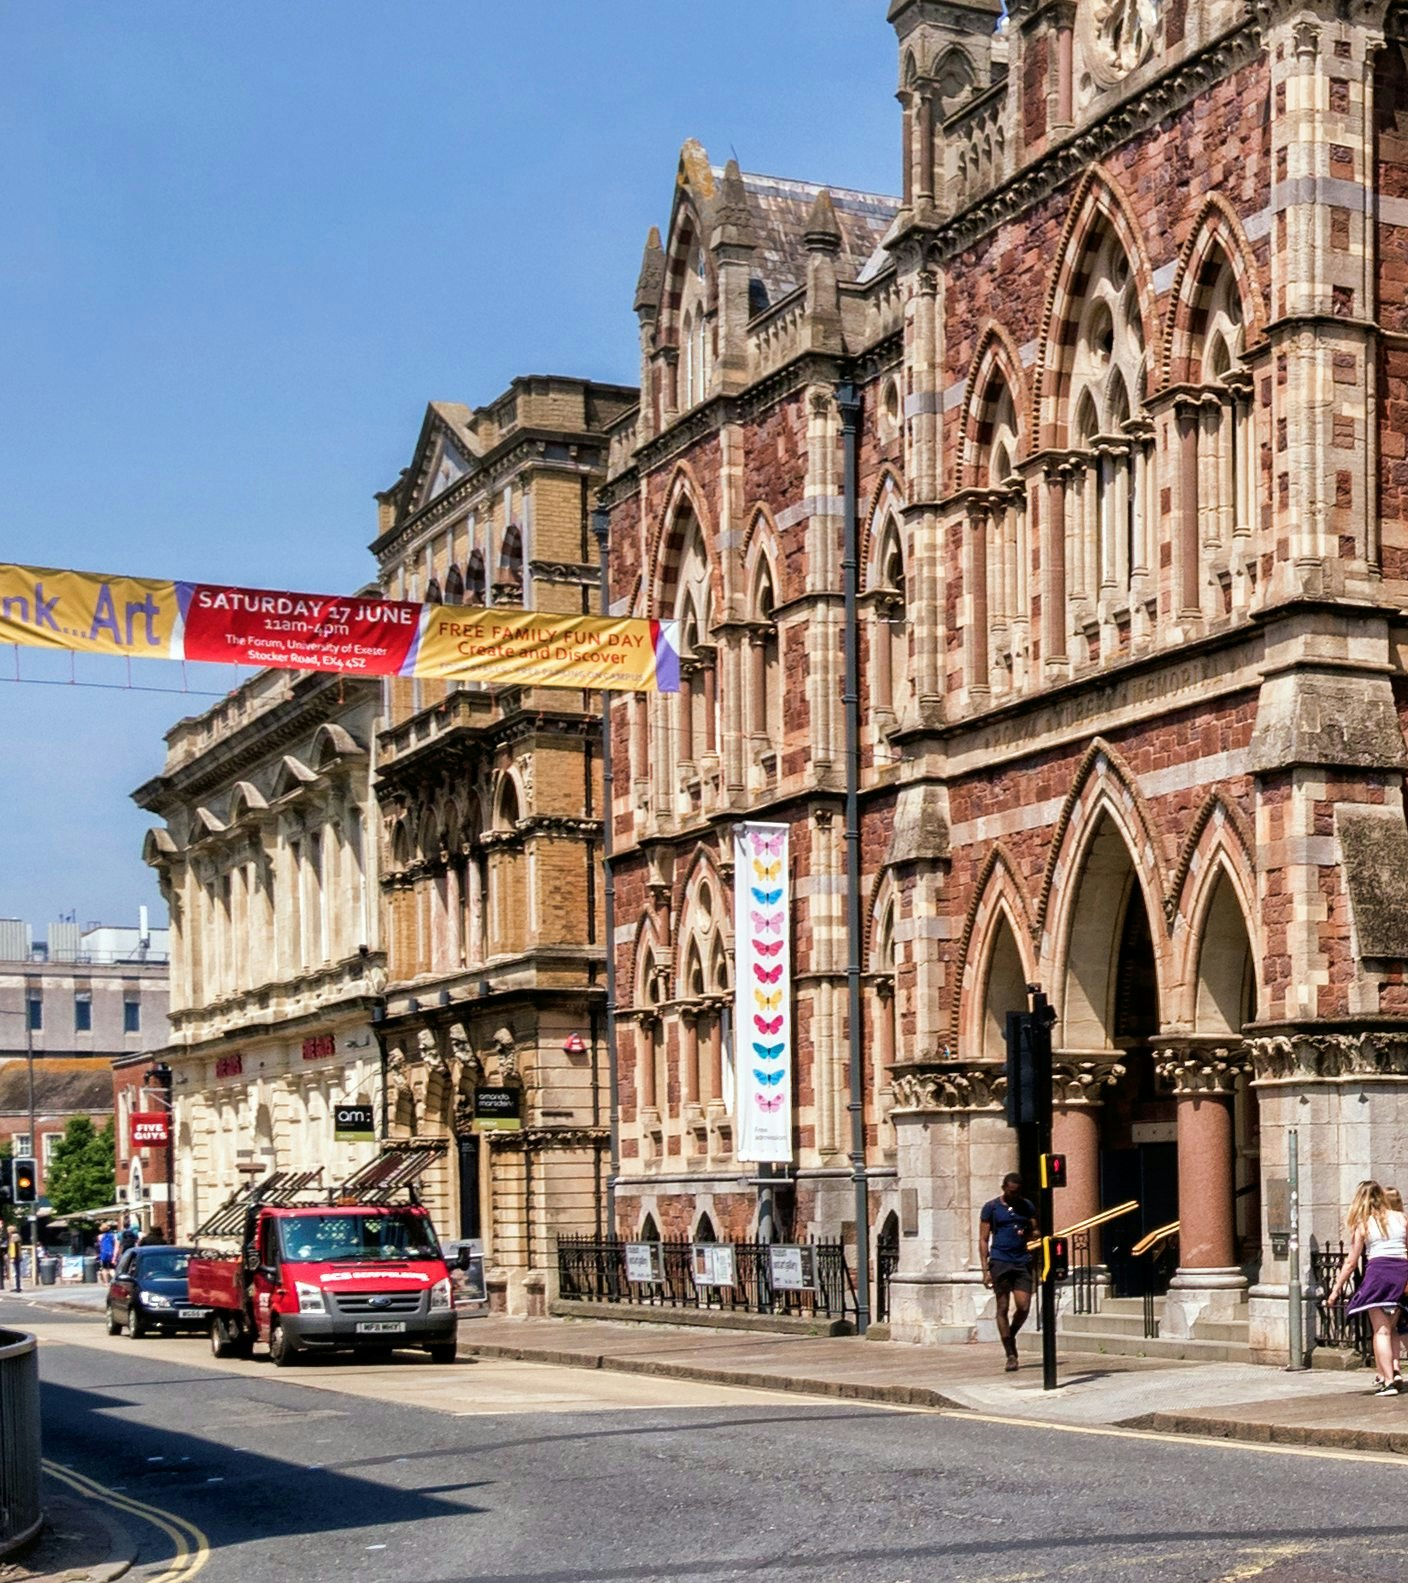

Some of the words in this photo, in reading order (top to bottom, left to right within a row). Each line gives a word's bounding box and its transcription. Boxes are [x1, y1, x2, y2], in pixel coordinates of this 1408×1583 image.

[198, 590, 324, 618] SATURDAY
[328, 606, 350, 623] 17
[354, 606, 413, 625] JUNE
[264, 619, 350, 638] 11am-4pm
[438, 621, 485, 638] FREE
[491, 625, 557, 643] FAMILY
[563, 630, 601, 646] FUN
[607, 633, 644, 648] DAY
[224, 633, 246, 646] The
[246, 635, 286, 650] Forum,
[286, 639, 339, 655] University
[340, 642, 353, 654] of
[353, 644, 388, 656] Exeter
[457, 640, 514, 658] Create
[518, 645, 550, 660] and
[555, 647, 628, 665] Discover
[247, 649, 289, 663] Stocker
[289, 652, 321, 667] Road,
[322, 654, 344, 670] EX4
[478, 1093, 511, 1101] amanda
[133, 1131, 168, 1140] GUYS
[136, 1123, 164, 1132] FIVE
